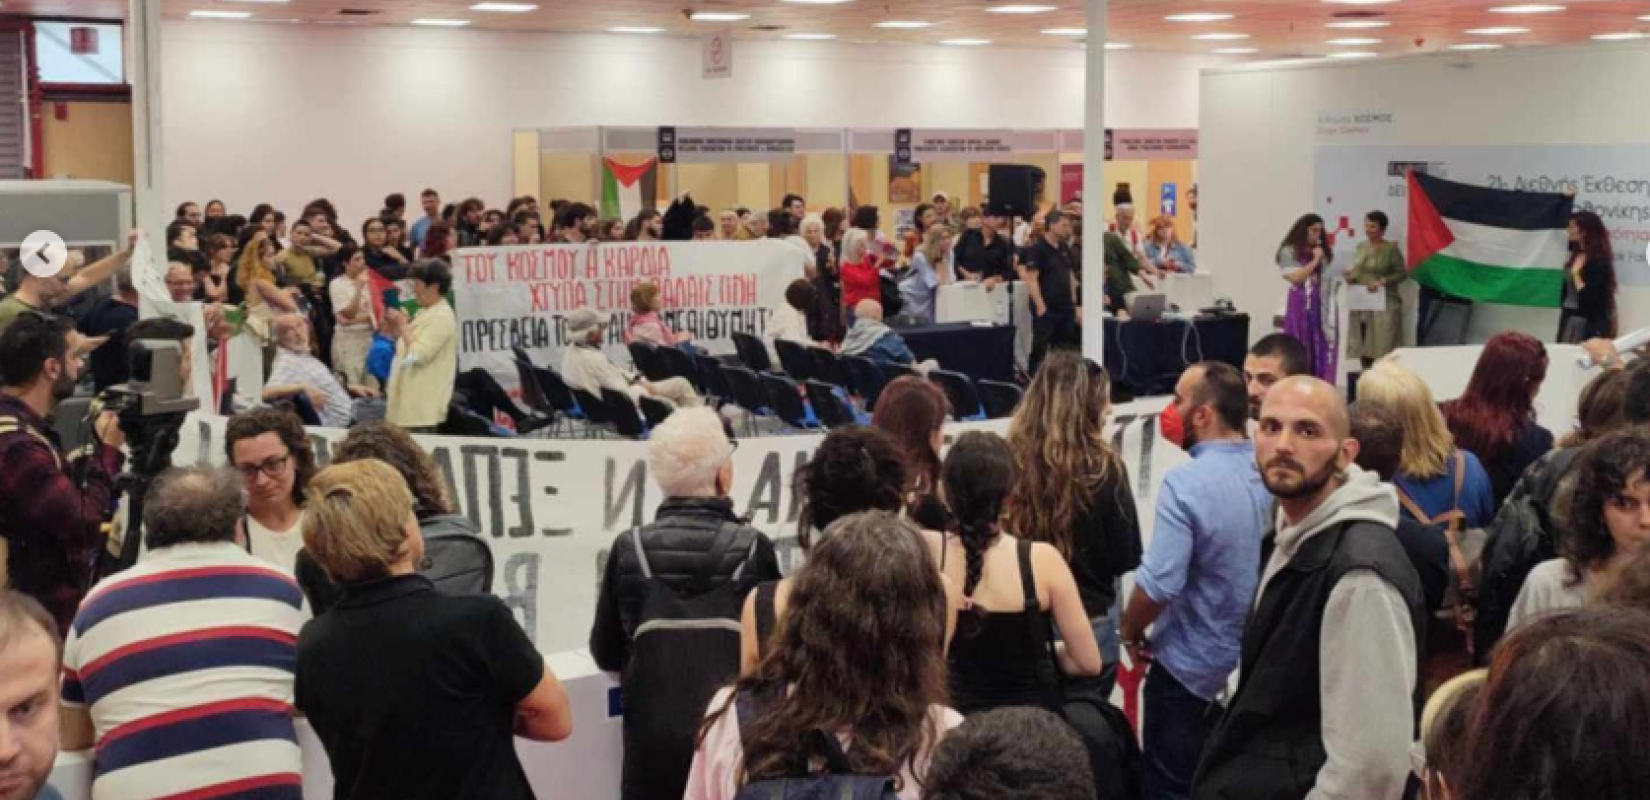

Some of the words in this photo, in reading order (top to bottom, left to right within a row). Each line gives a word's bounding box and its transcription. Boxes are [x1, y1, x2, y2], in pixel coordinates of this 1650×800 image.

[460, 253, 497, 283] ΤΟΥ
[506, 248, 578, 281] ΚΟΣΜΟΥ
[605, 245, 670, 278] ΚΑΡΔΙΑ
[530, 280, 588, 312] ΧΤΥΠΑ
[594, 277, 642, 310] ΣΤΗ
[654, 272, 758, 308] ΑΛΑΙΣΤΙΝΗ
[461, 314, 549, 353] ΠΡΕΣΒΕΙΑ
